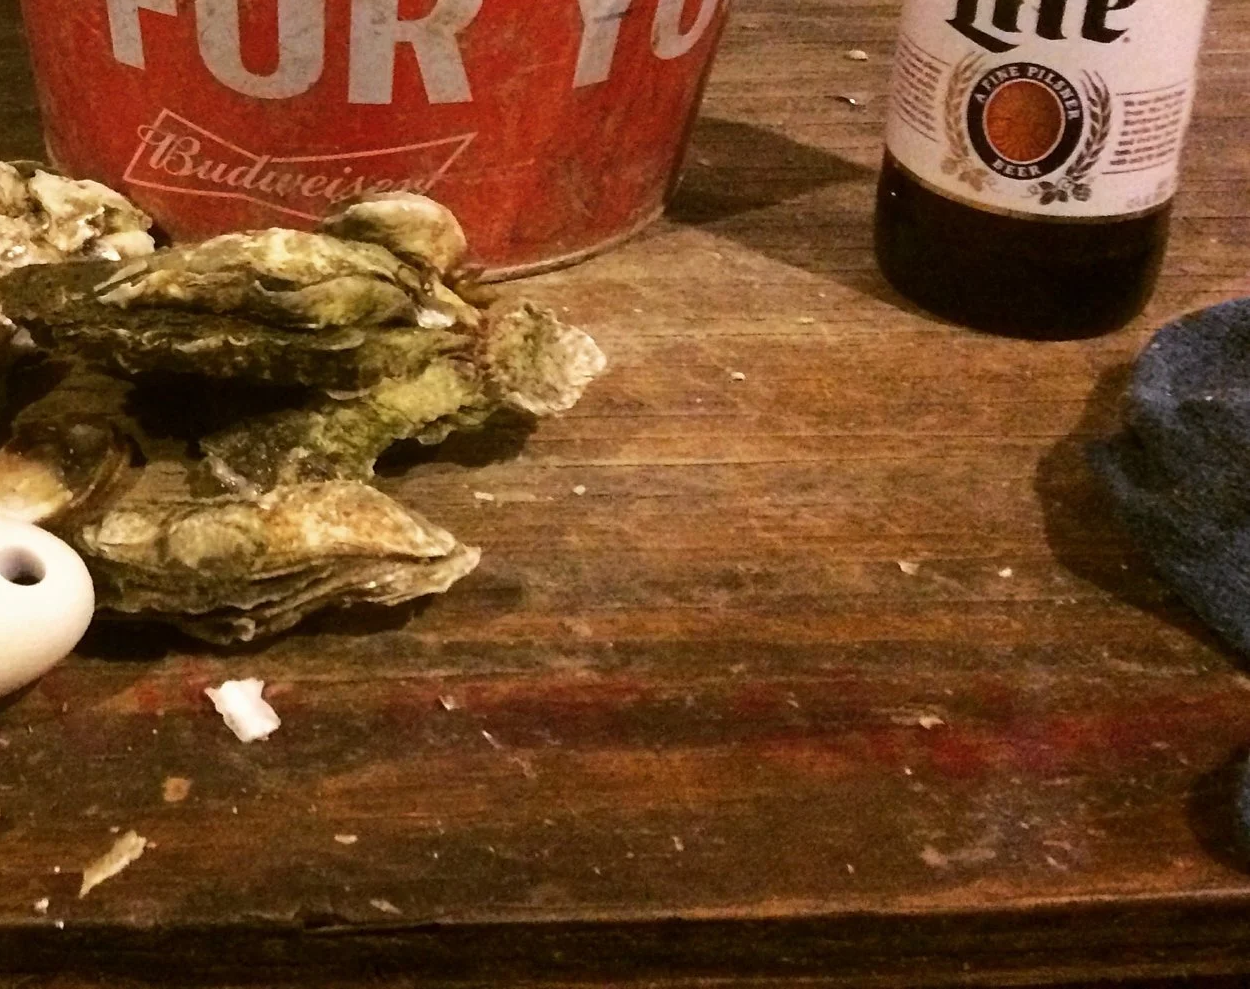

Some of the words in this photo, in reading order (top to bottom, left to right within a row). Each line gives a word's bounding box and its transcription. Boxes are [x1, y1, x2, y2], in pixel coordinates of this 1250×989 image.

[974, 92, 987, 104] A
[981, 65, 1021, 91] FINE
[1027, 65, 1082, 121] PILSNER
[992, 159, 1042, 177] BEER
